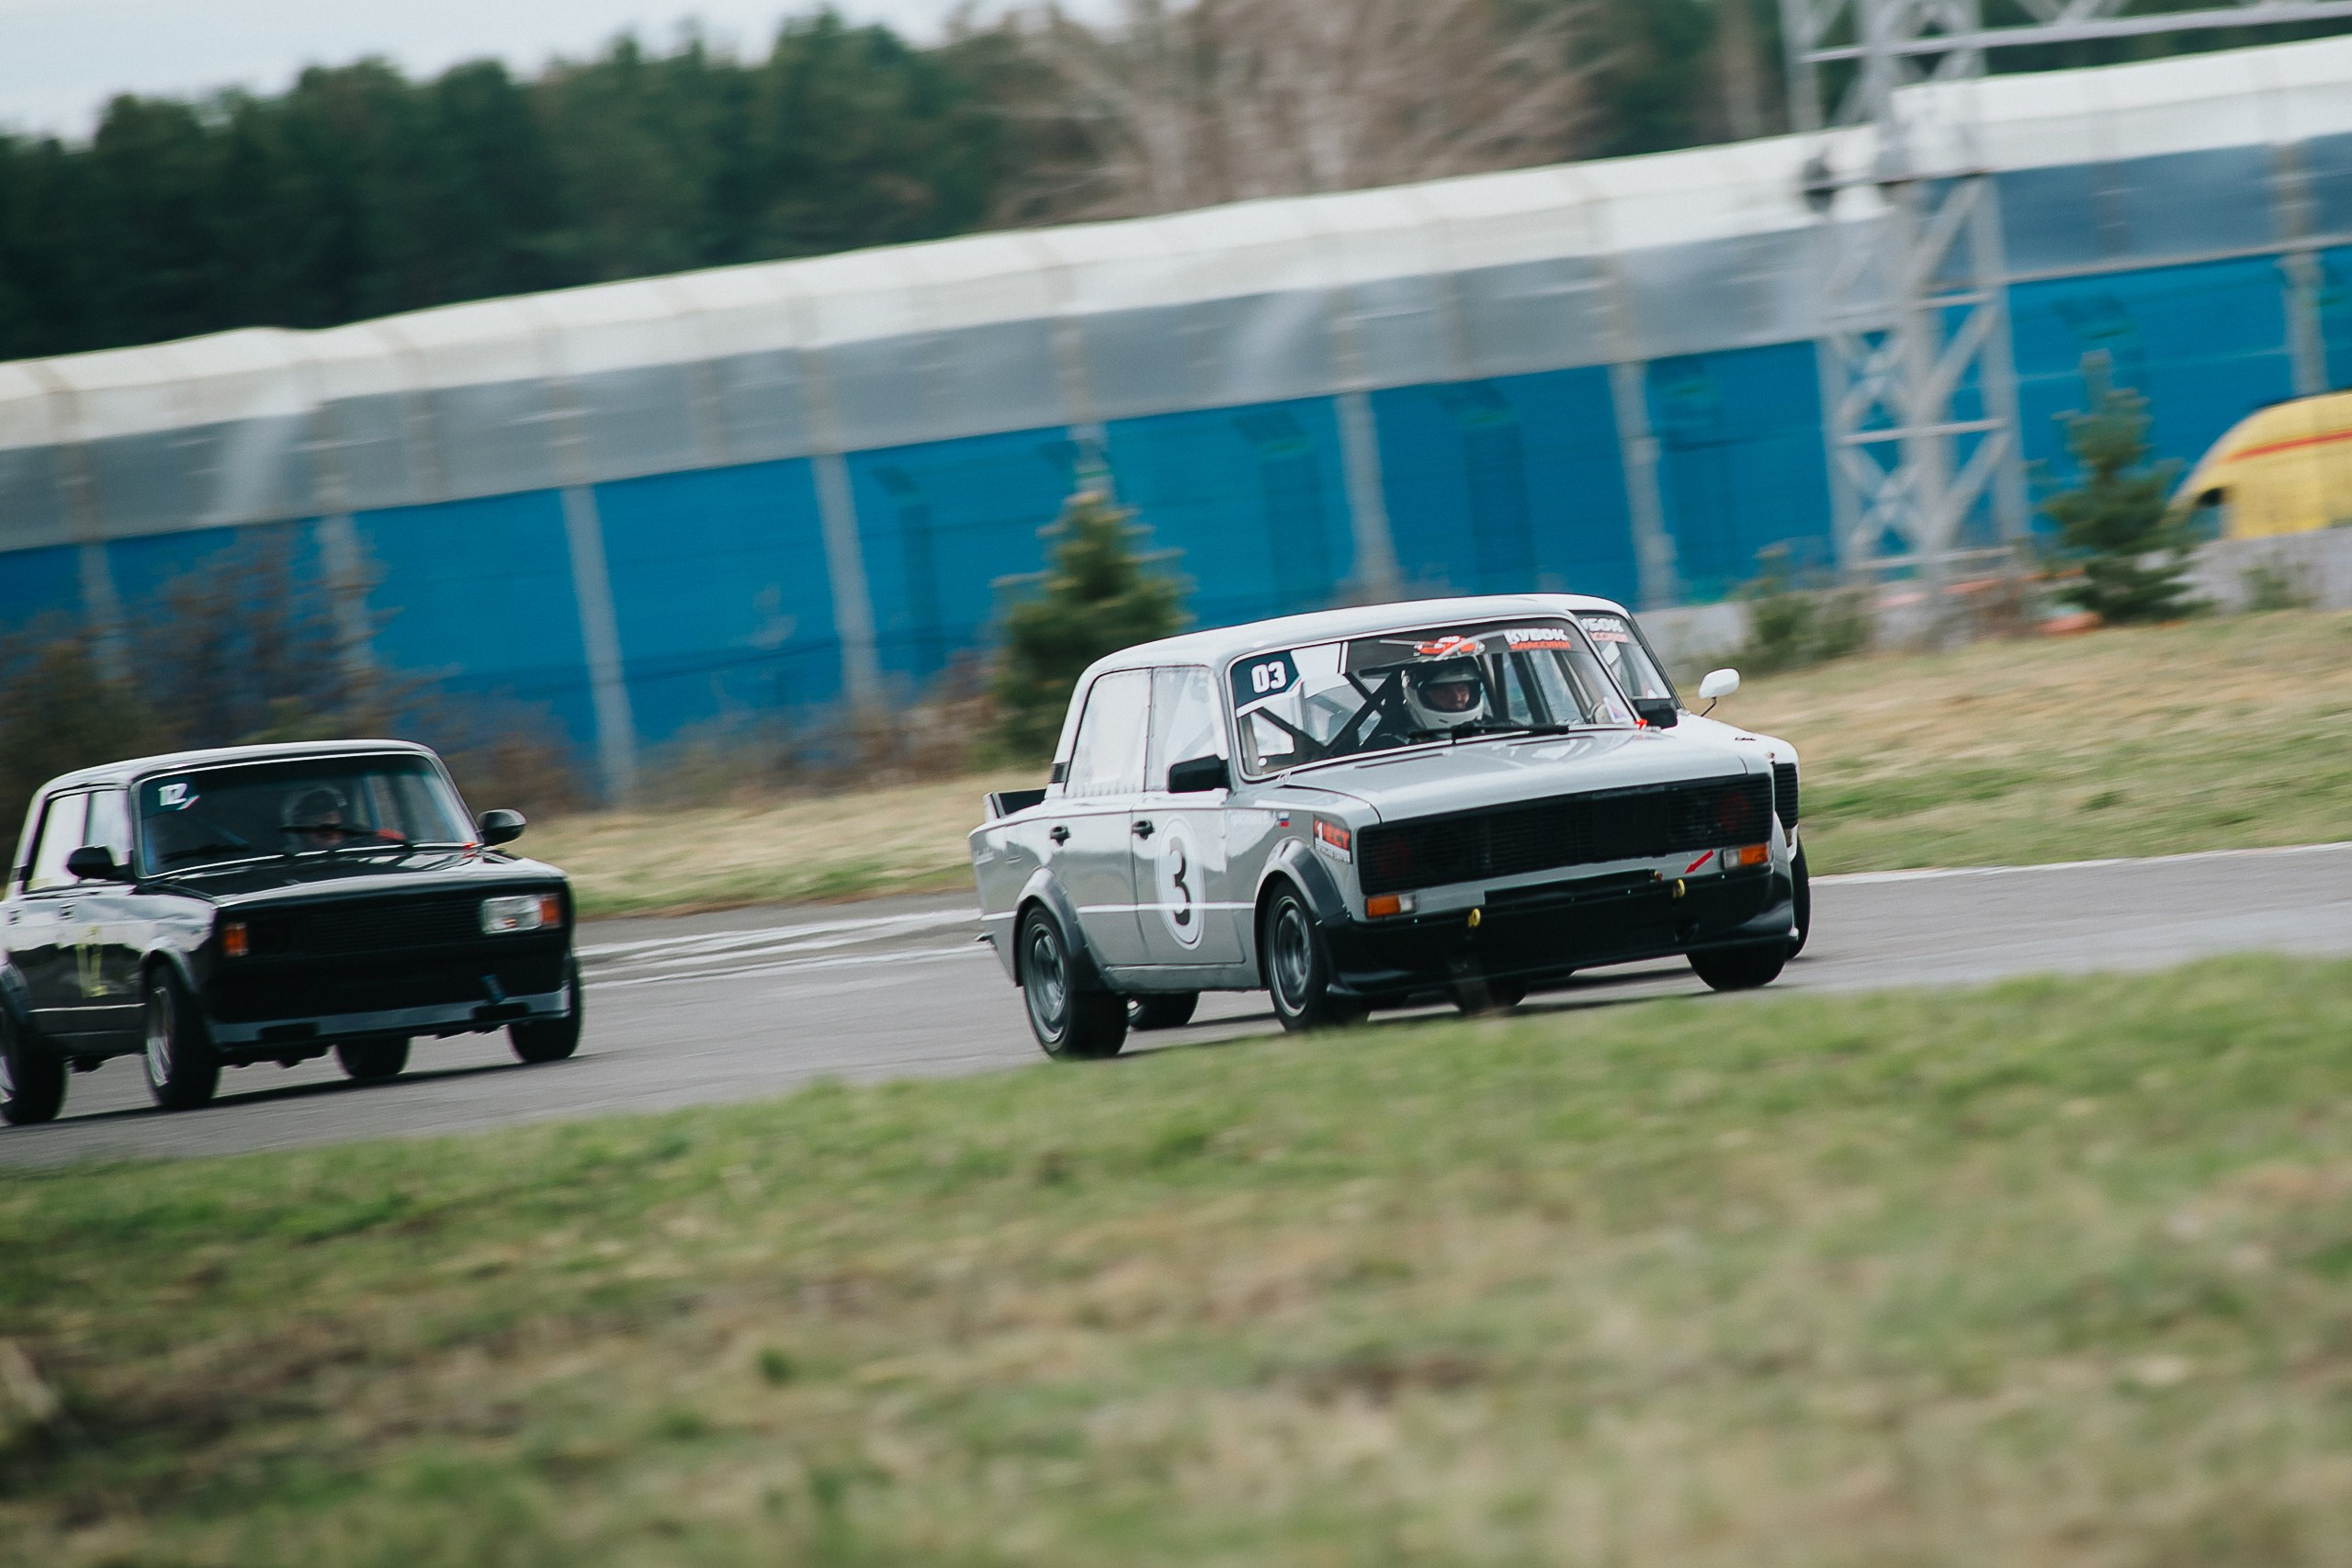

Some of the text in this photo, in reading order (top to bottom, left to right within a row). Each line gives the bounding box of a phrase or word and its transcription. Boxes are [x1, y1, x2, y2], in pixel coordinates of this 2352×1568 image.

[1503, 628, 1568, 644] КУБОК
[1251, 661, 1286, 694] 03
[158, 783, 187, 807] 12
[1170, 836, 1191, 926] 3
